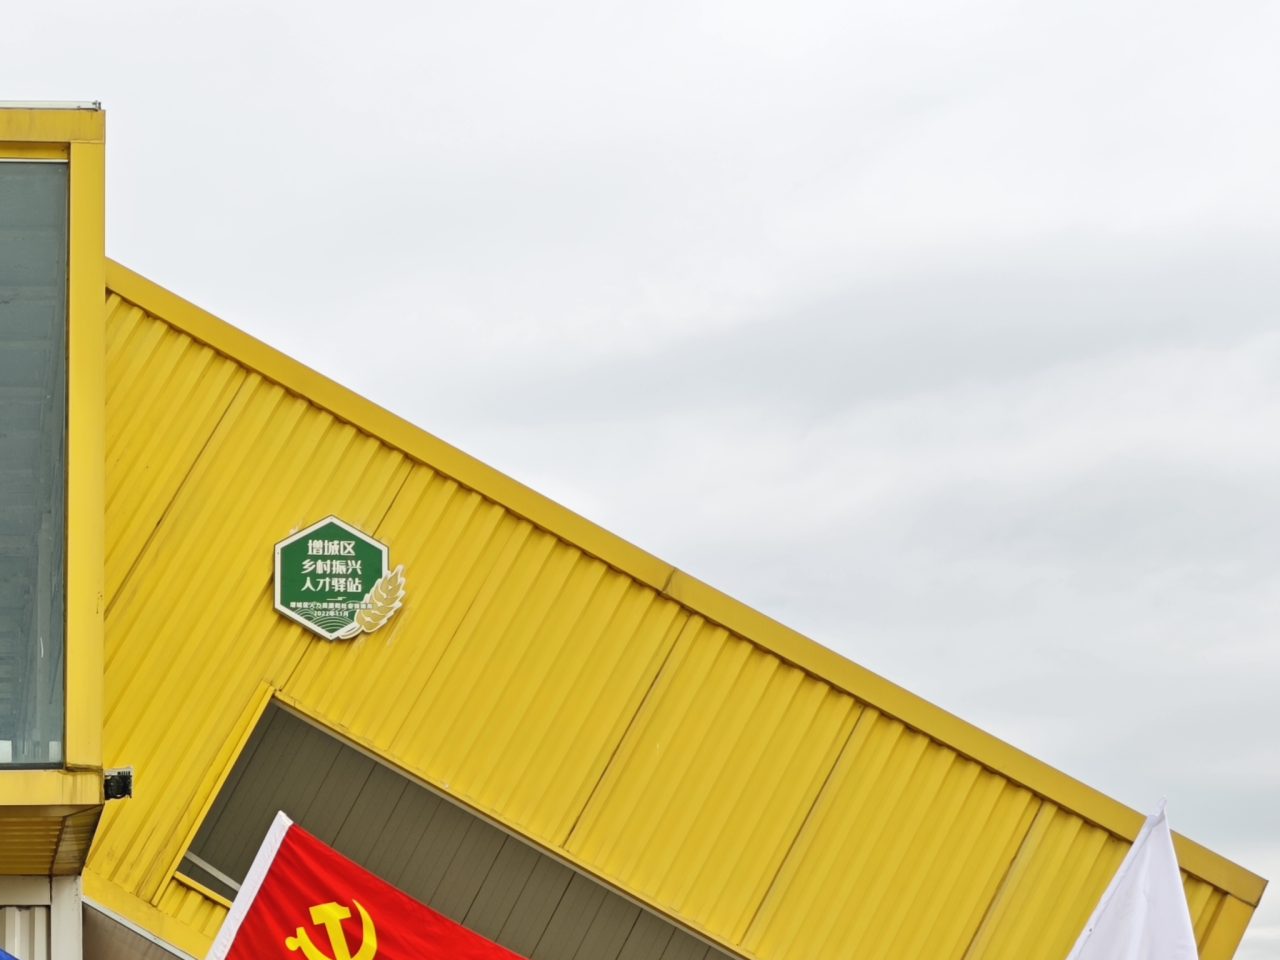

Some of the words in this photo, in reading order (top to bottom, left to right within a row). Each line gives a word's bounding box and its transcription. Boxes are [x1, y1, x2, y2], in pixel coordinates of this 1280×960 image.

[307, 539, 356, 556] 增城区
[300, 558, 362, 575] 乡村振兴
[300, 576, 362, 593] 人才驿站
